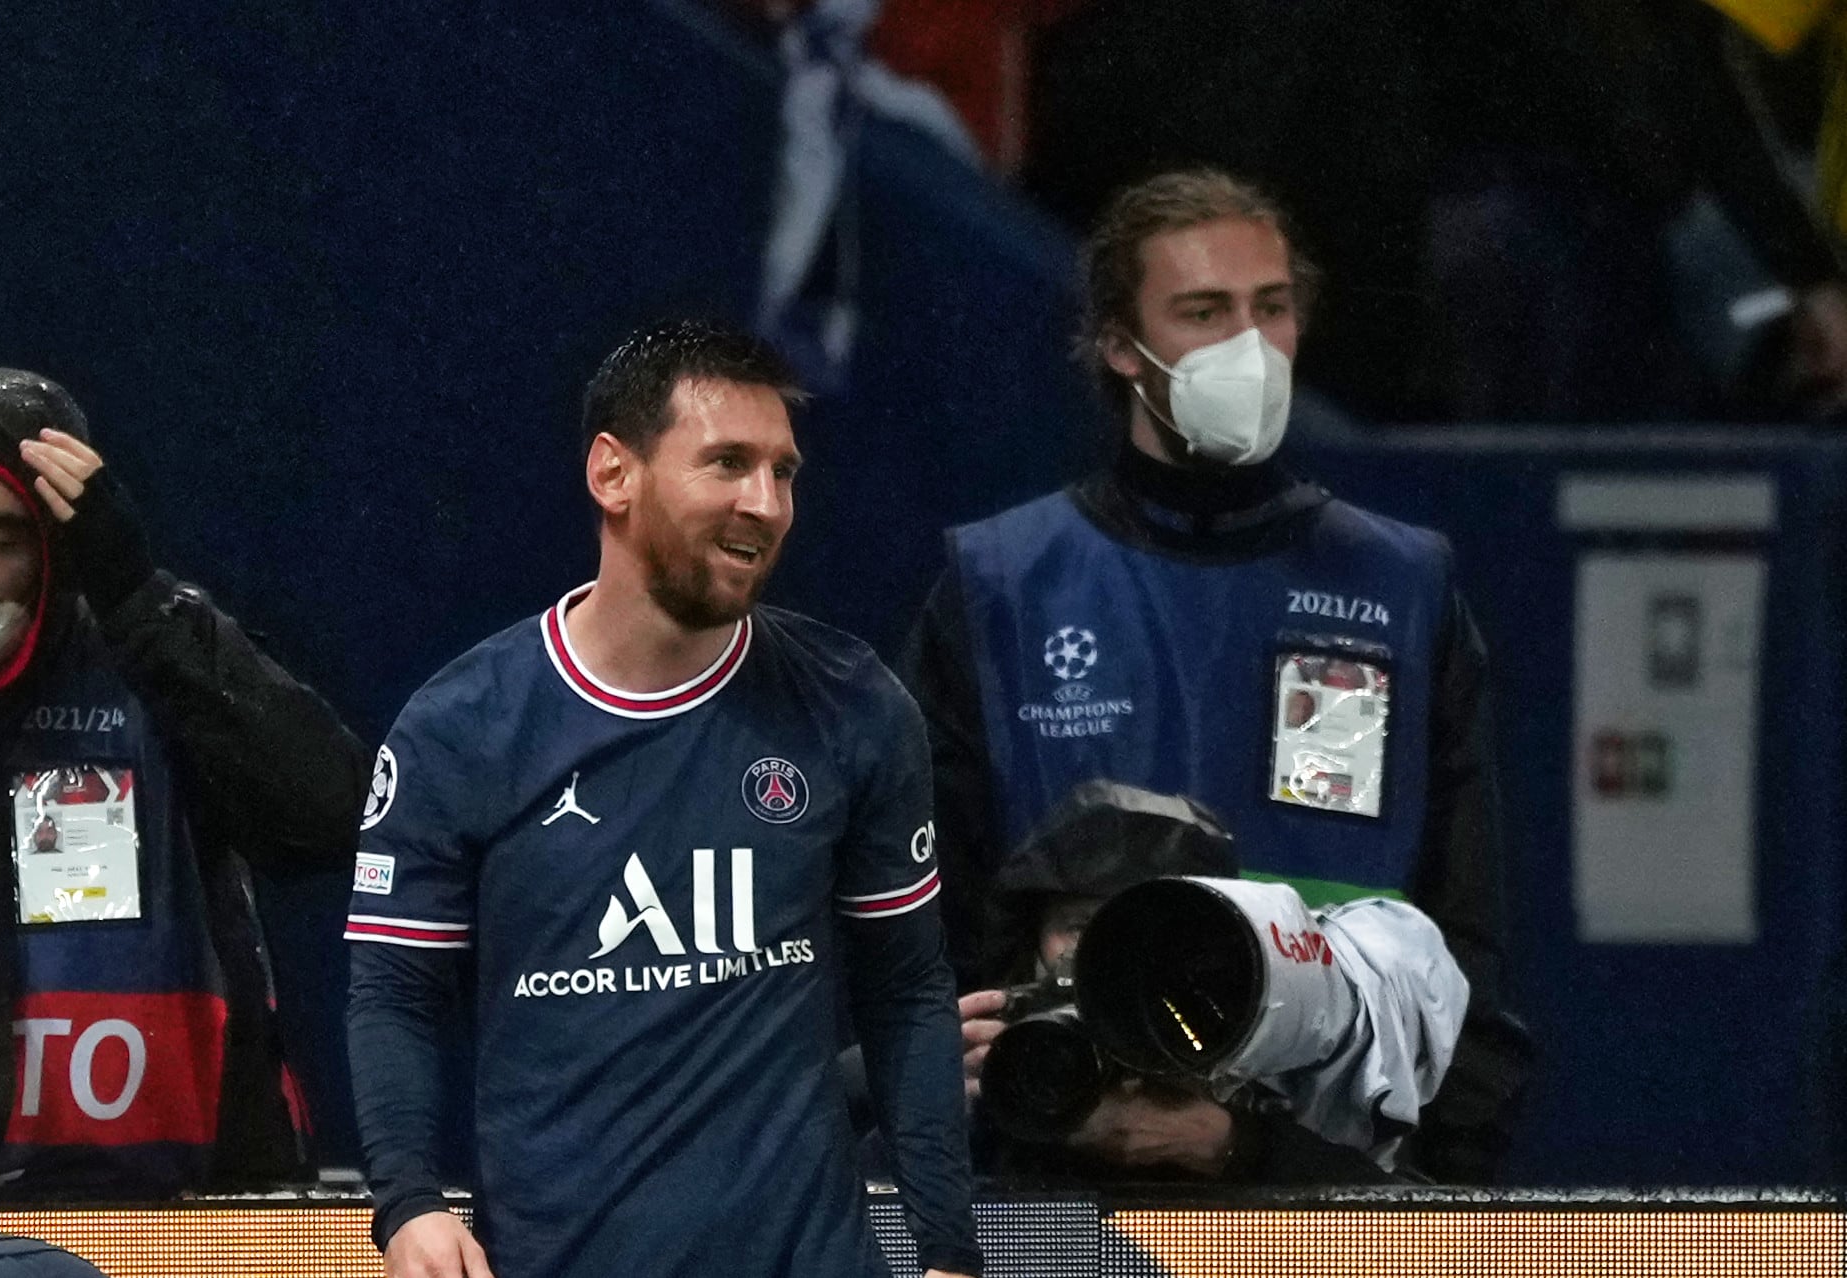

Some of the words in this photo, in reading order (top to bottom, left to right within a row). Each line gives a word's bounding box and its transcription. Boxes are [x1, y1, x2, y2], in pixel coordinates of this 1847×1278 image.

[1287, 589, 1390, 627] 2021/24
[21, 705, 126, 732] 2021/24
[1018, 700, 1133, 721] CHAMPIONS
[1039, 718, 1113, 738] LEAGUE
[752, 761, 795, 778] PARIS
[513, 967, 618, 998] ACCOR
[624, 963, 693, 993] LIVE
